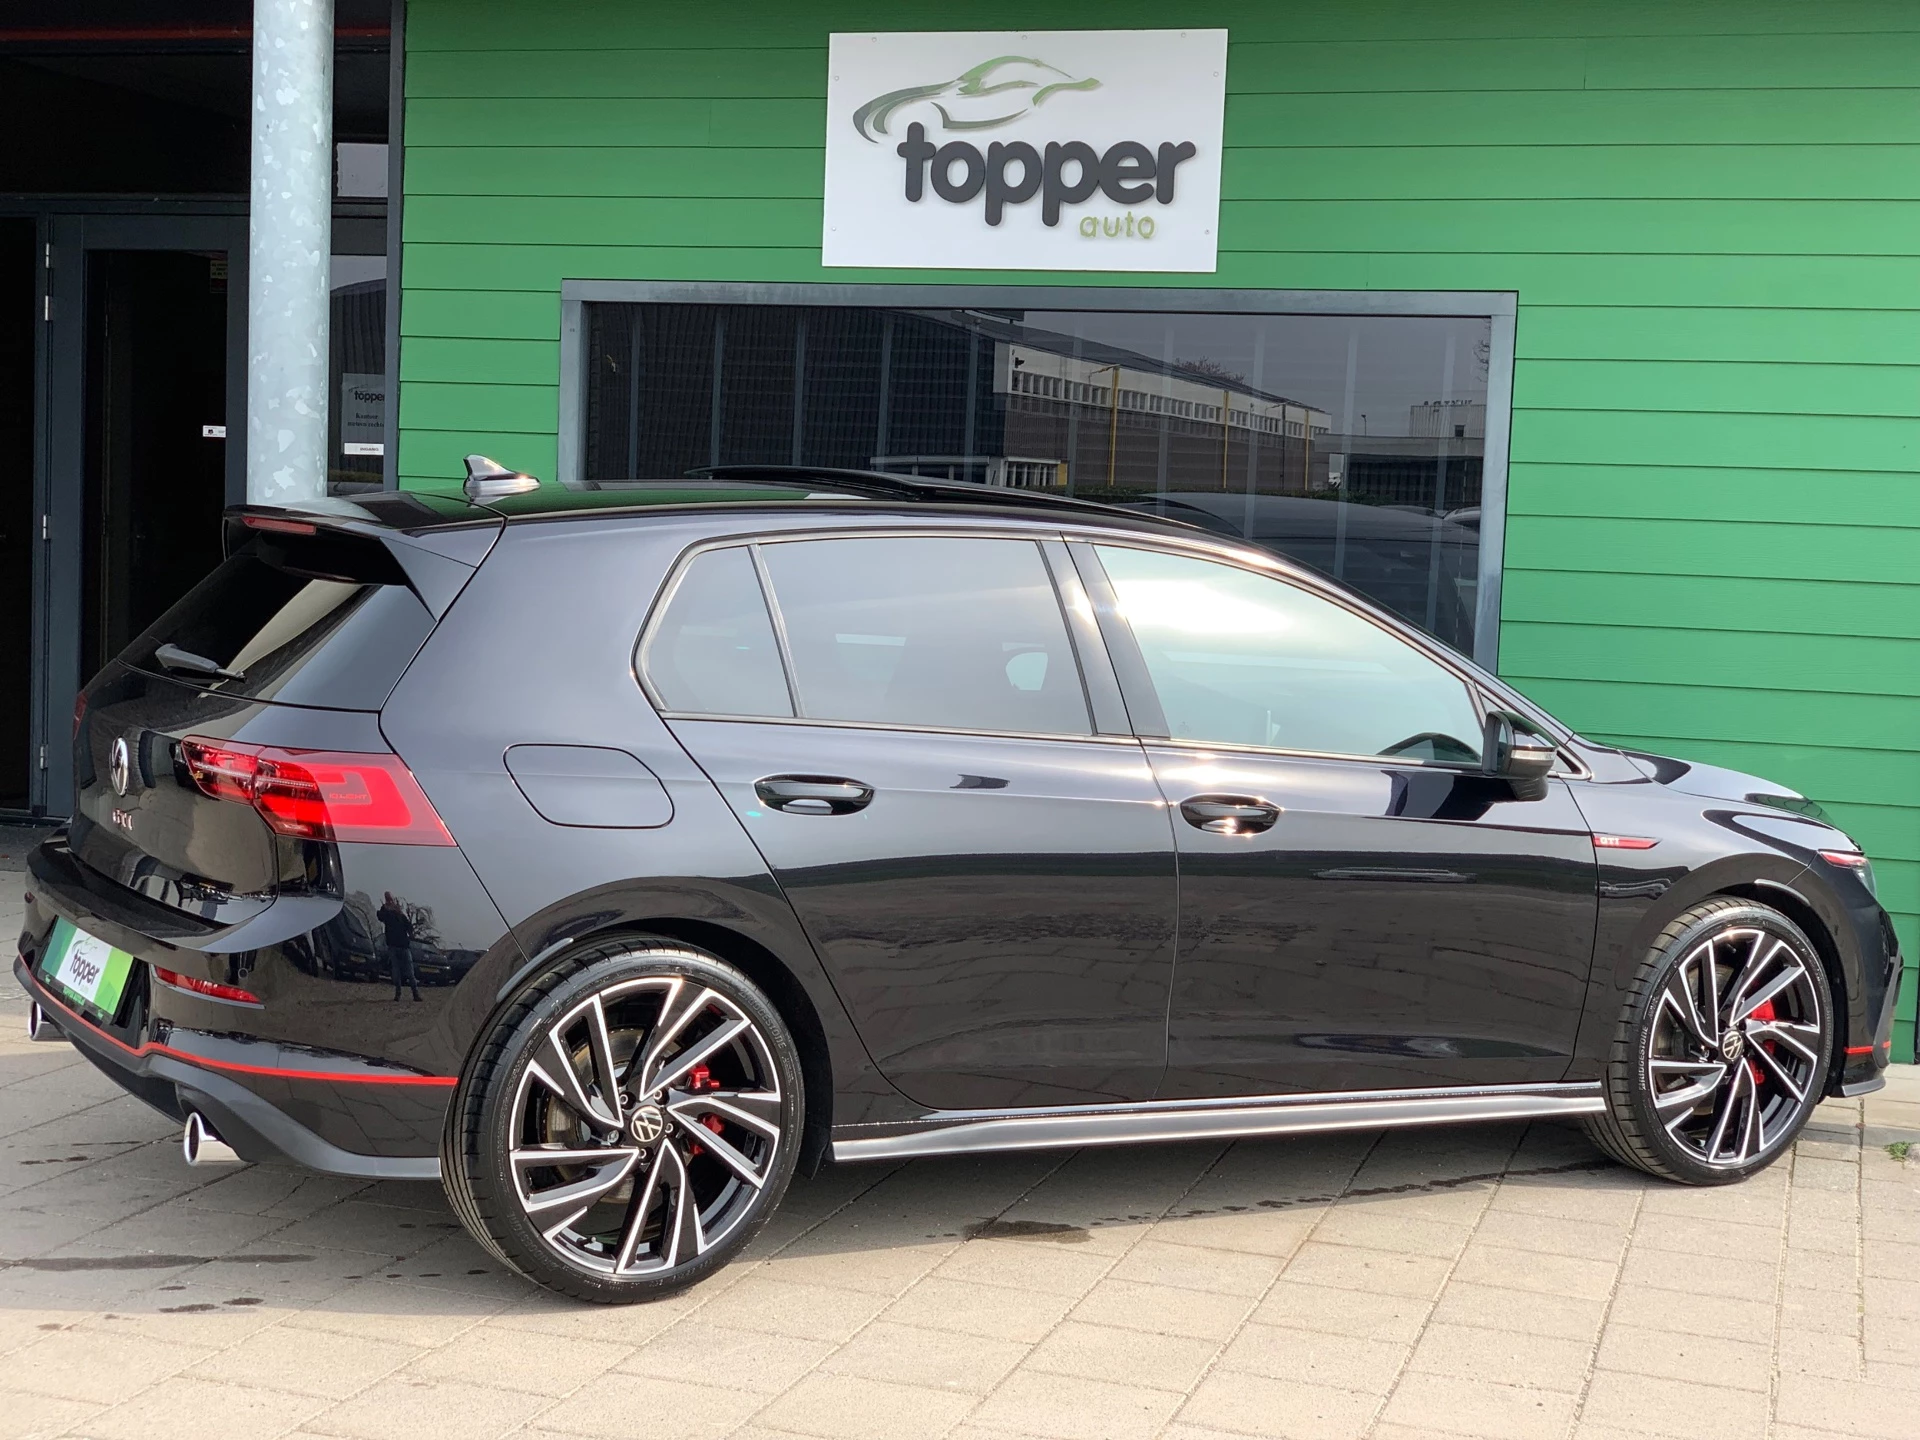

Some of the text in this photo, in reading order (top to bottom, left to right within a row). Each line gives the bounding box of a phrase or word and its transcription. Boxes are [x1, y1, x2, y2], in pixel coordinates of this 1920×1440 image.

[897, 121, 1197, 227] topper
[1079, 211, 1155, 239] auto
[1599, 836, 1620, 846] GTI
